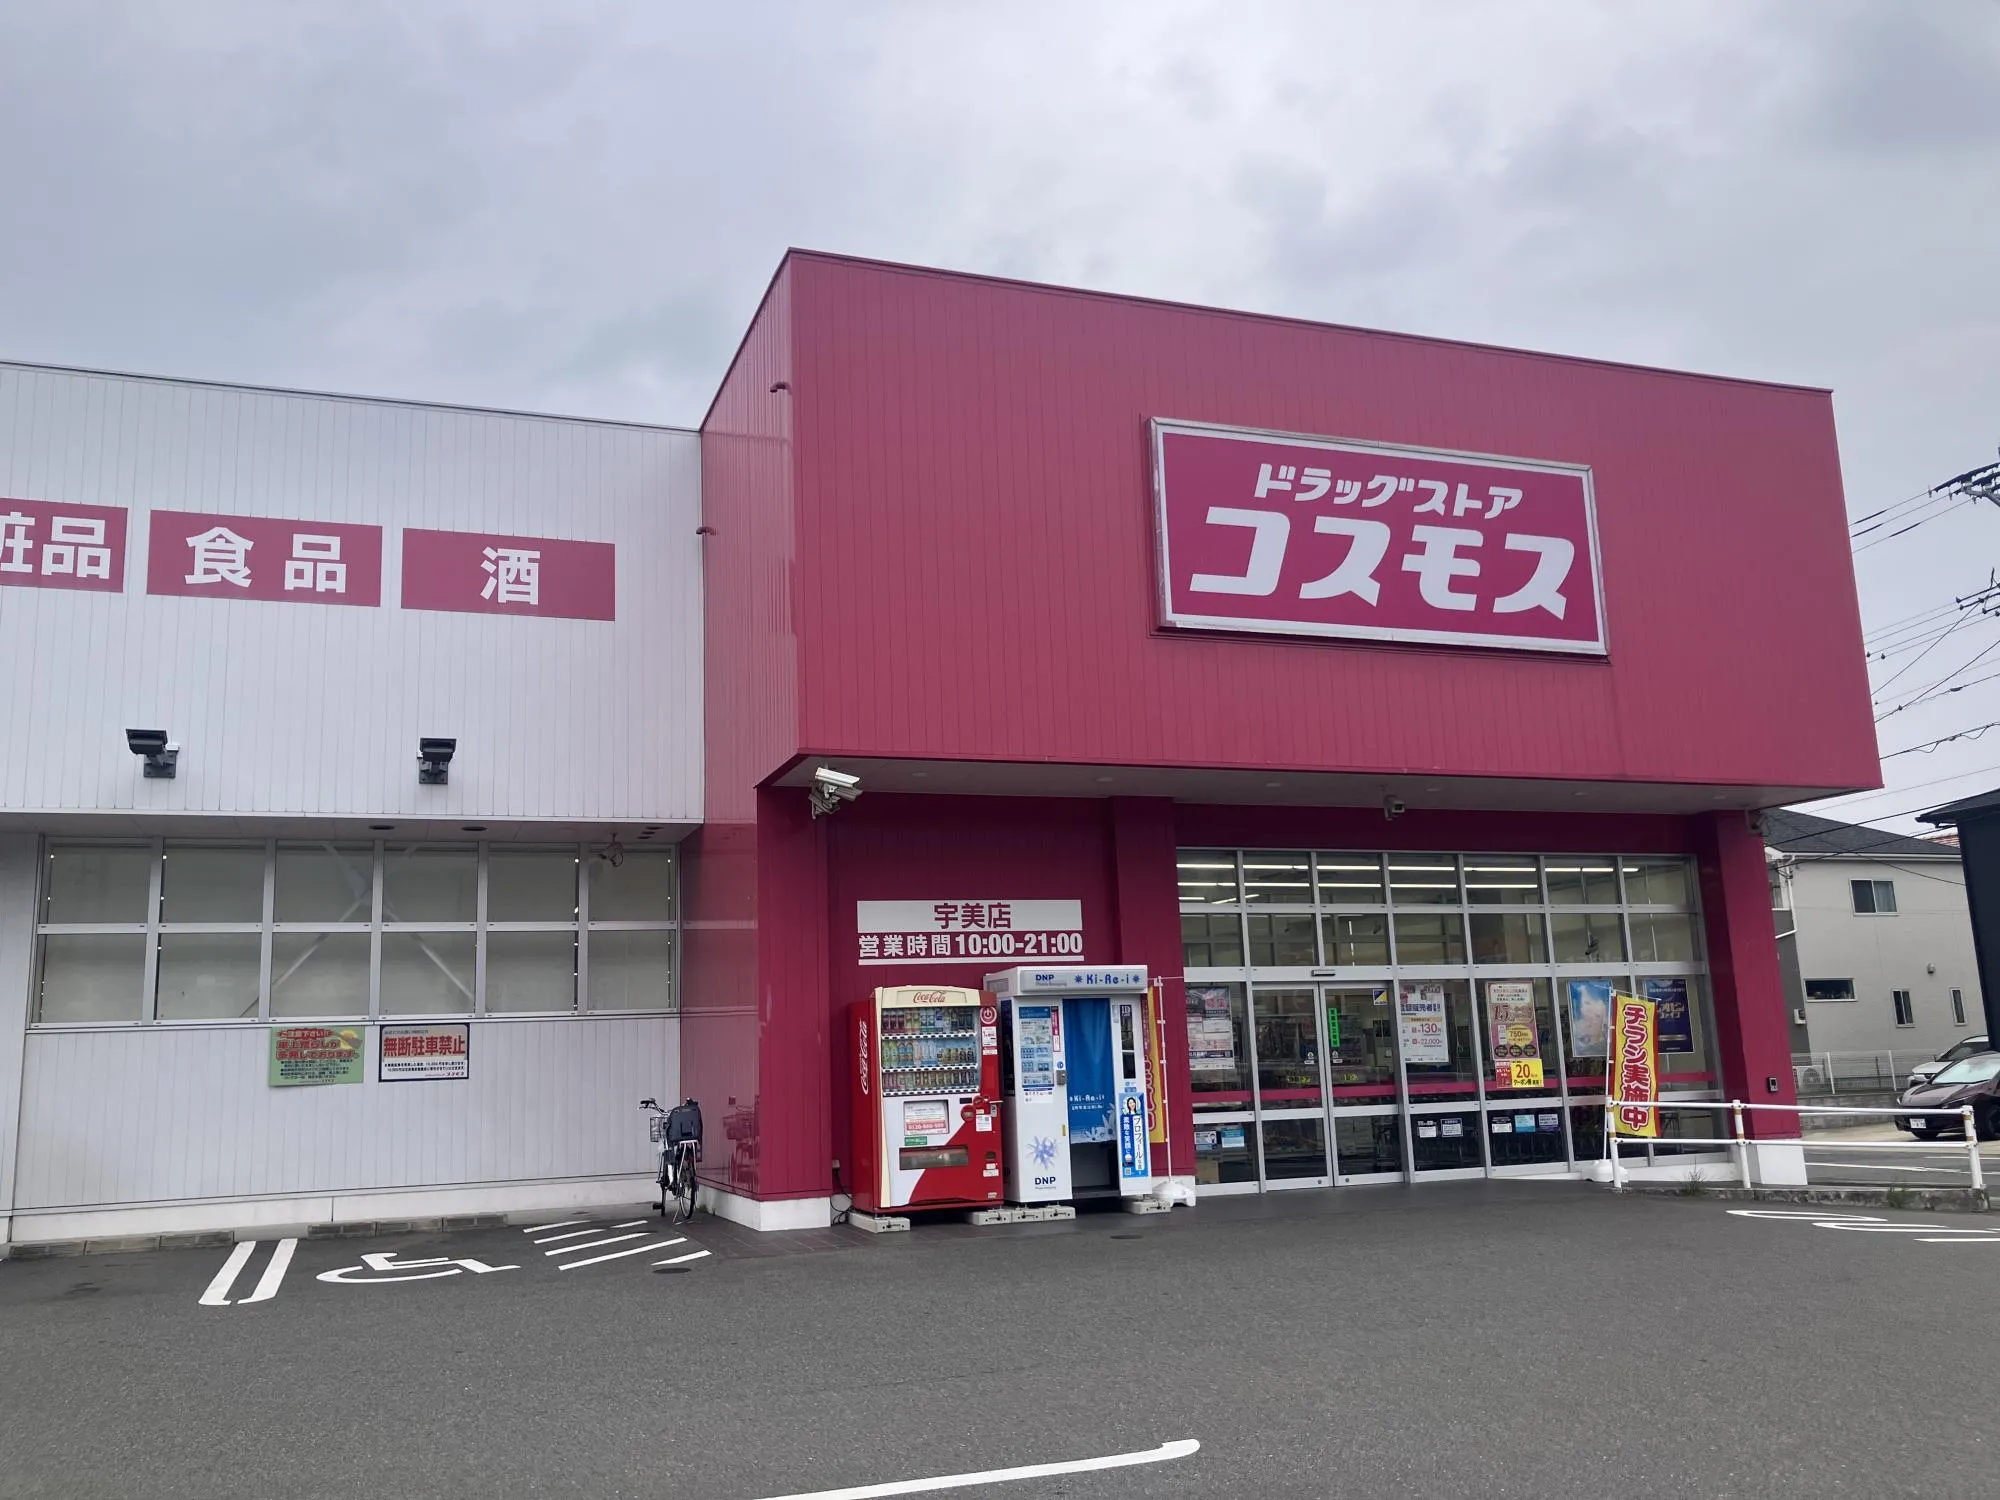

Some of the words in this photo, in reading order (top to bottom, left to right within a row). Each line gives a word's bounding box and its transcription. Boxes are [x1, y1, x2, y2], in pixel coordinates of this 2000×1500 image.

[1254, 463, 1523, 519] ドラッグストア
[184, 526, 347, 593] 食品
[480, 546, 541, 605] 酒
[1189, 506, 1575, 620] コスモス
[934, 902, 1011, 929] 宇美店
[384, 1036, 465, 1056] 無断駐車禁止
[1035, 1176, 1056, 1185] DNP
